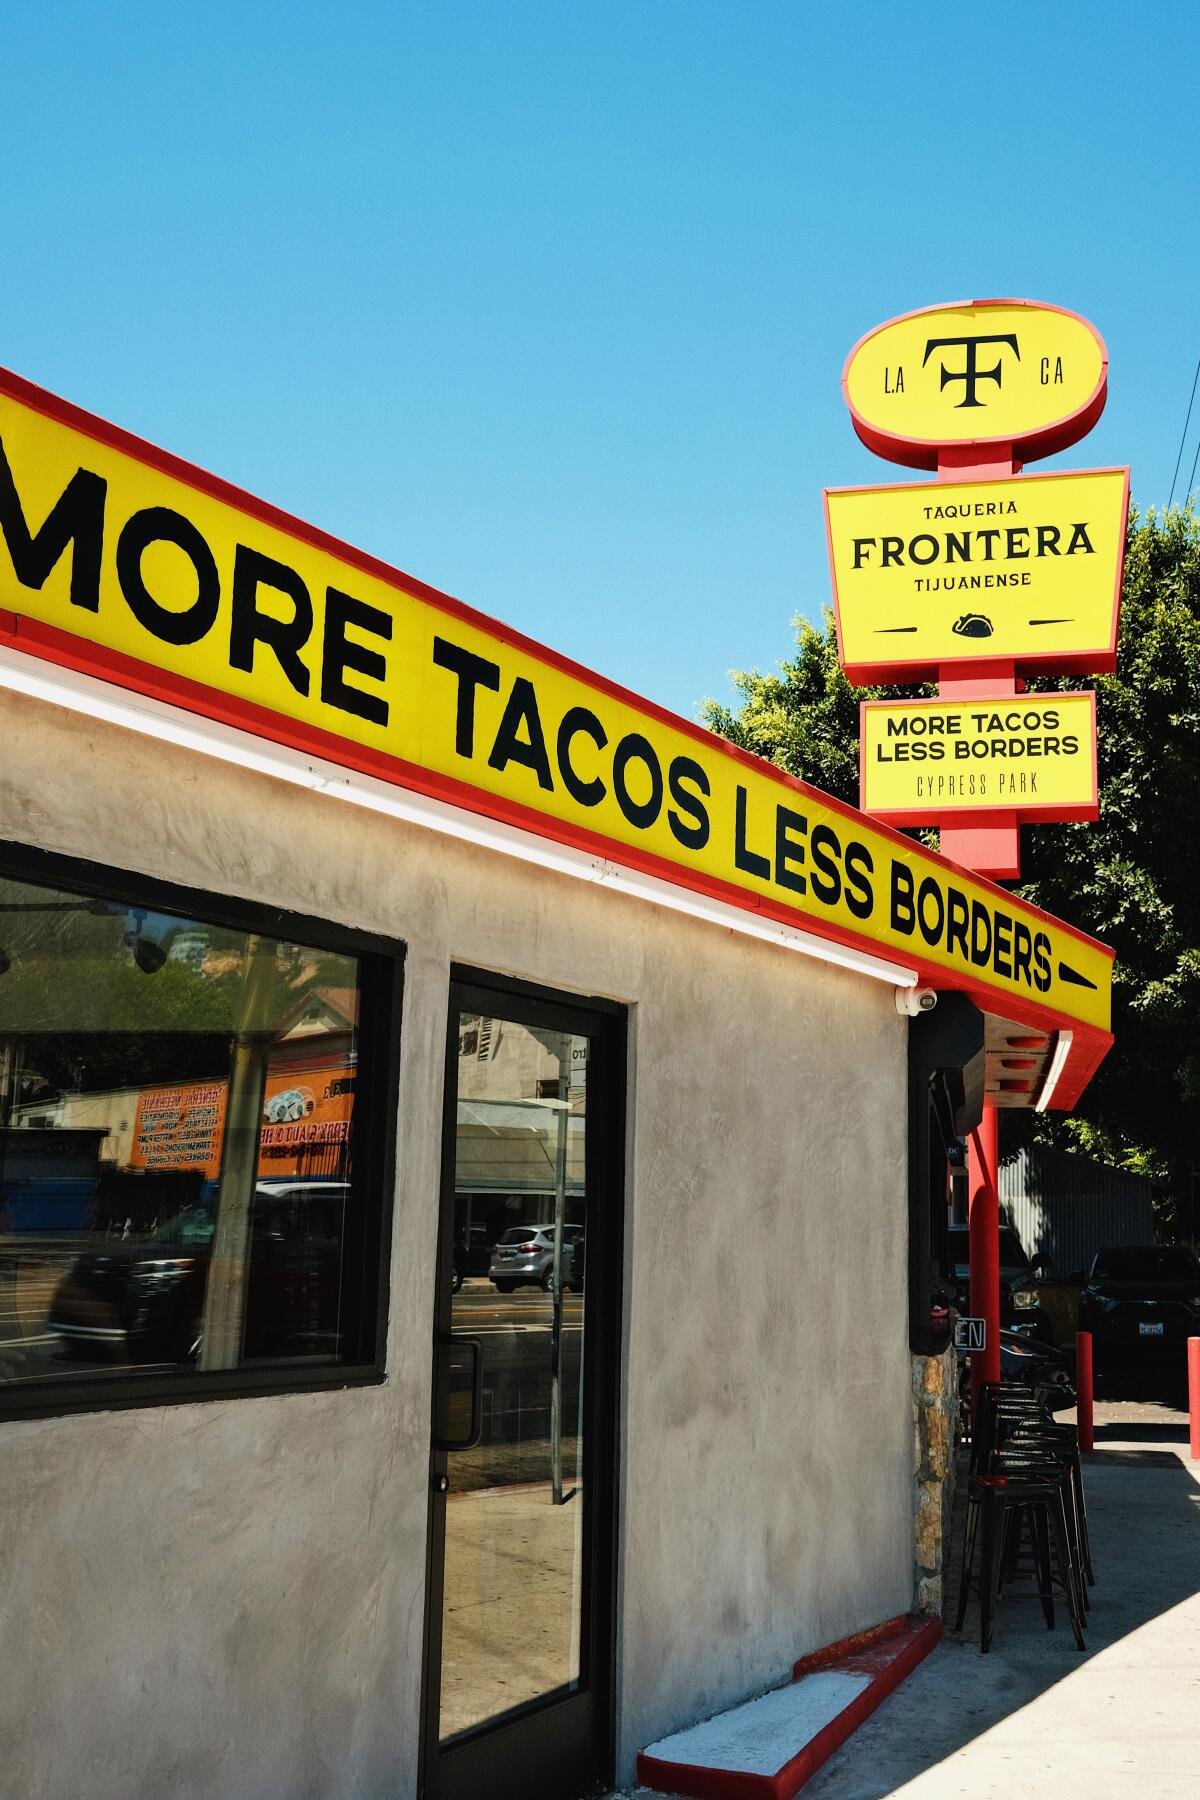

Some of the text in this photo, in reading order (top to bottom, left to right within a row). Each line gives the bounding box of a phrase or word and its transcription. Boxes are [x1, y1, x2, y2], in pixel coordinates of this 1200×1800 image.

[1040, 356, 1064, 386] CA
[923, 500, 1018, 520] TAQUERIA
[850, 522, 1098, 570] FRONTERA
[915, 572, 1032, 592] TIJUANENSE
[0, 434, 1053, 994] MORE TACOS LESS BORDERS
[887, 710, 1060, 737] MORE TACOS
[877, 735, 1079, 763] LESS BORDERS
[917, 771, 1038, 798] CYPRESS PARK
